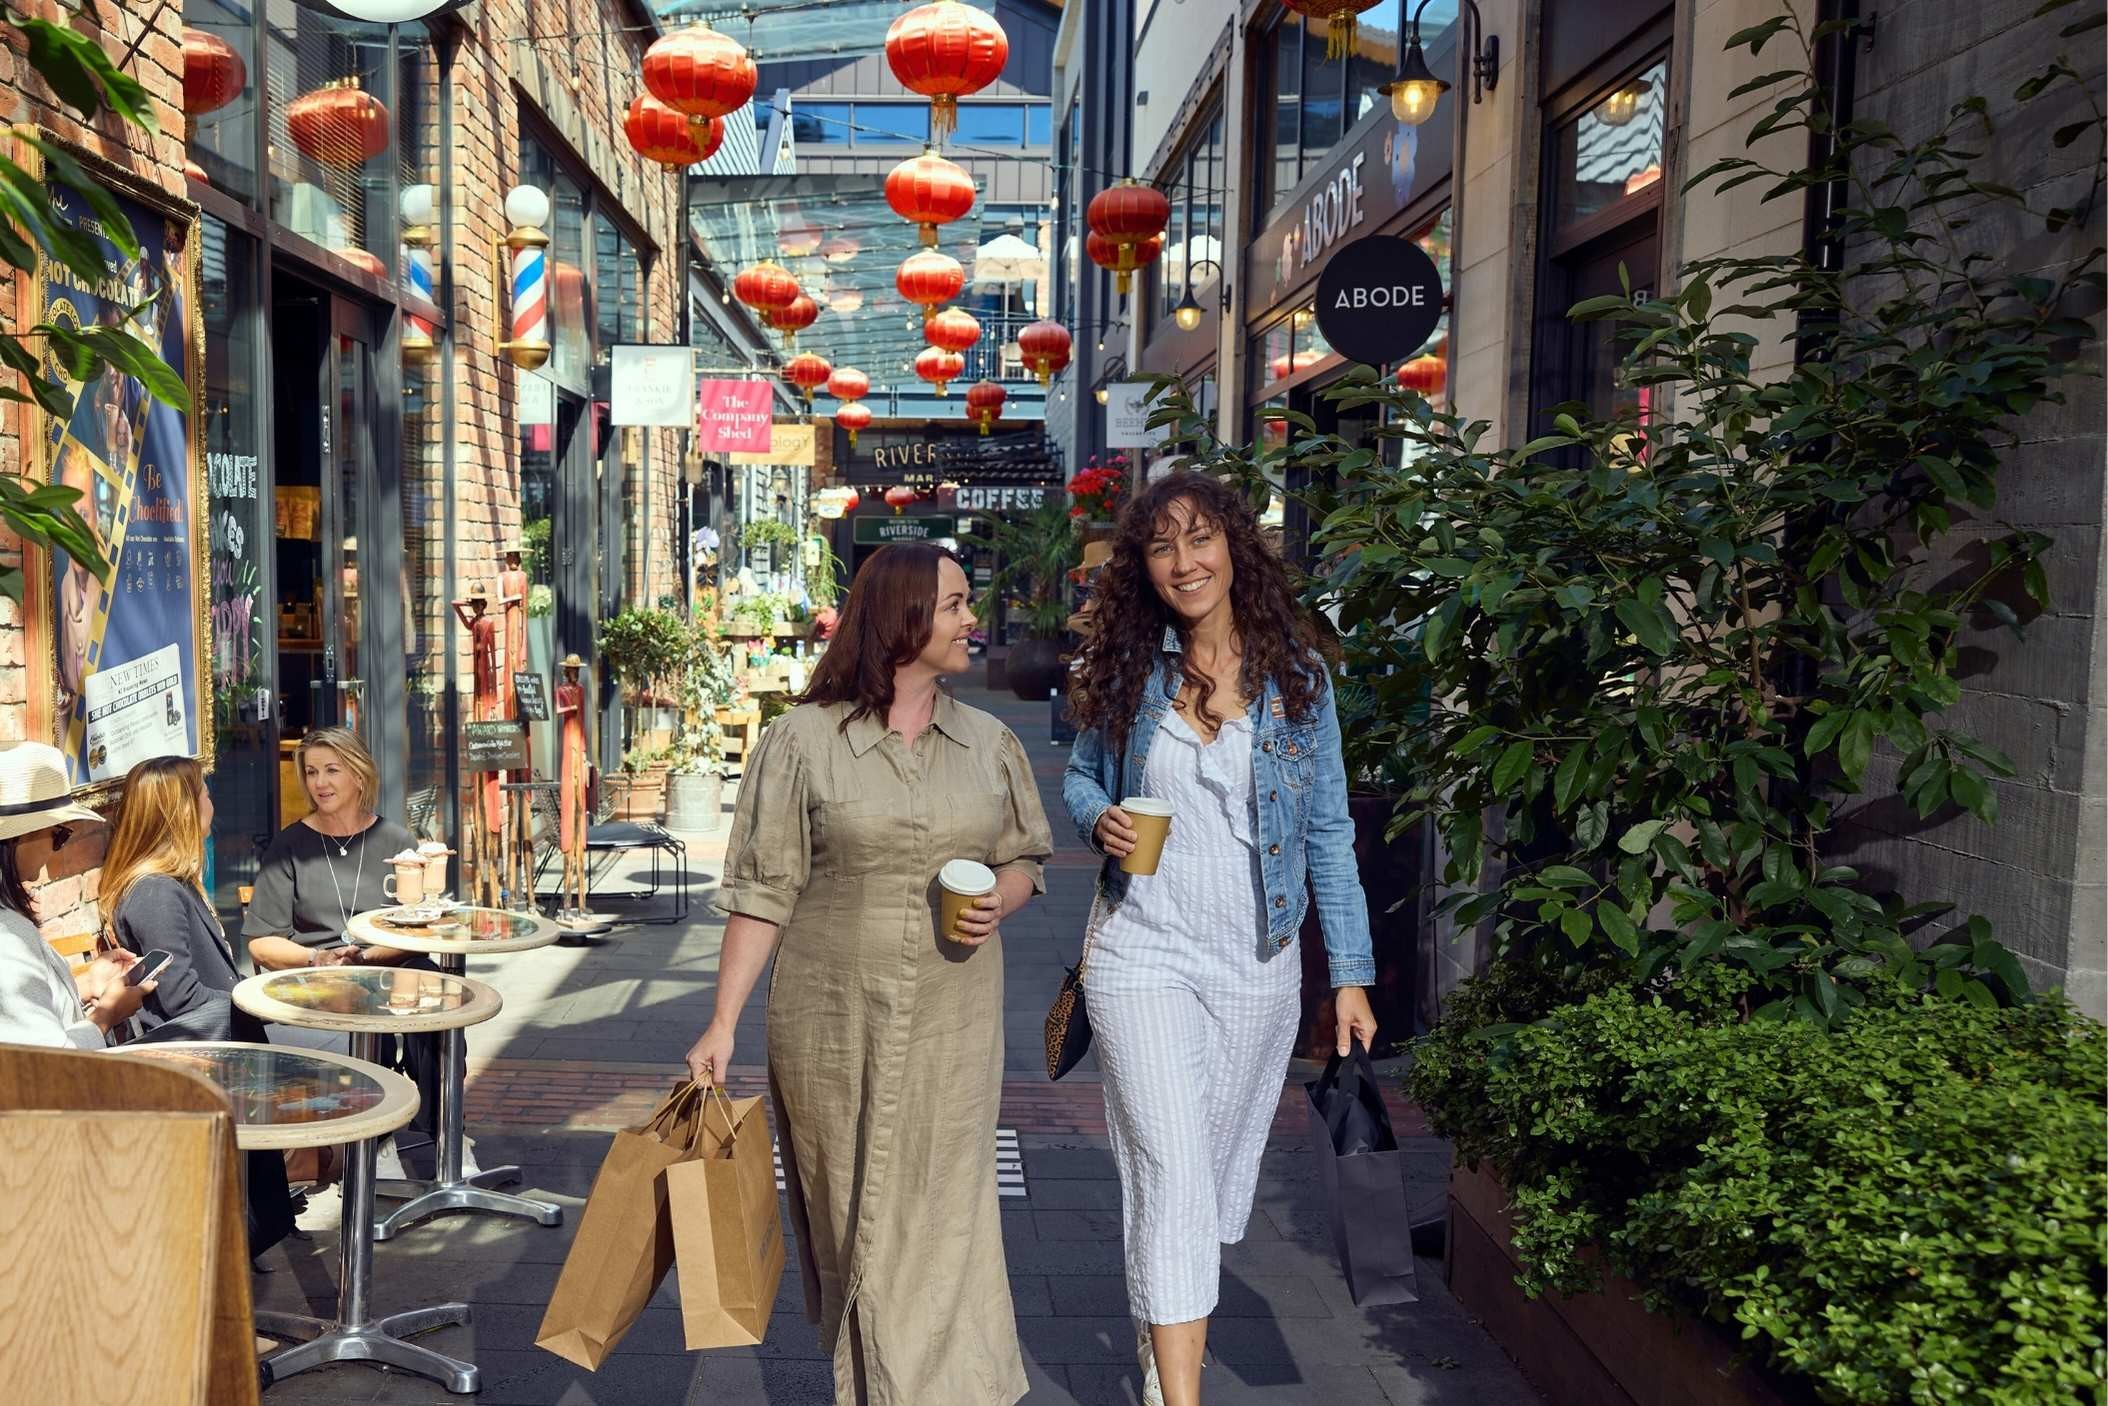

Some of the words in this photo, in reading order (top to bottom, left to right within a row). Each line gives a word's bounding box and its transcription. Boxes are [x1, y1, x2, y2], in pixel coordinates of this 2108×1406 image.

[1300, 152, 1365, 269] ABODE
[1335, 285, 1425, 309] ABODE
[722, 395, 750, 408] The
[702, 409, 768, 430] Company
[718, 426, 752, 439] Shed
[875, 443, 936, 468] RIVER
[904, 474, 934, 483] MAR
[956, 489, 1044, 510] COFFEE
[880, 524, 929, 538] RIVERSIDE
[110, 668, 130, 689] NEW
[134, 657, 159, 677] TIMES
